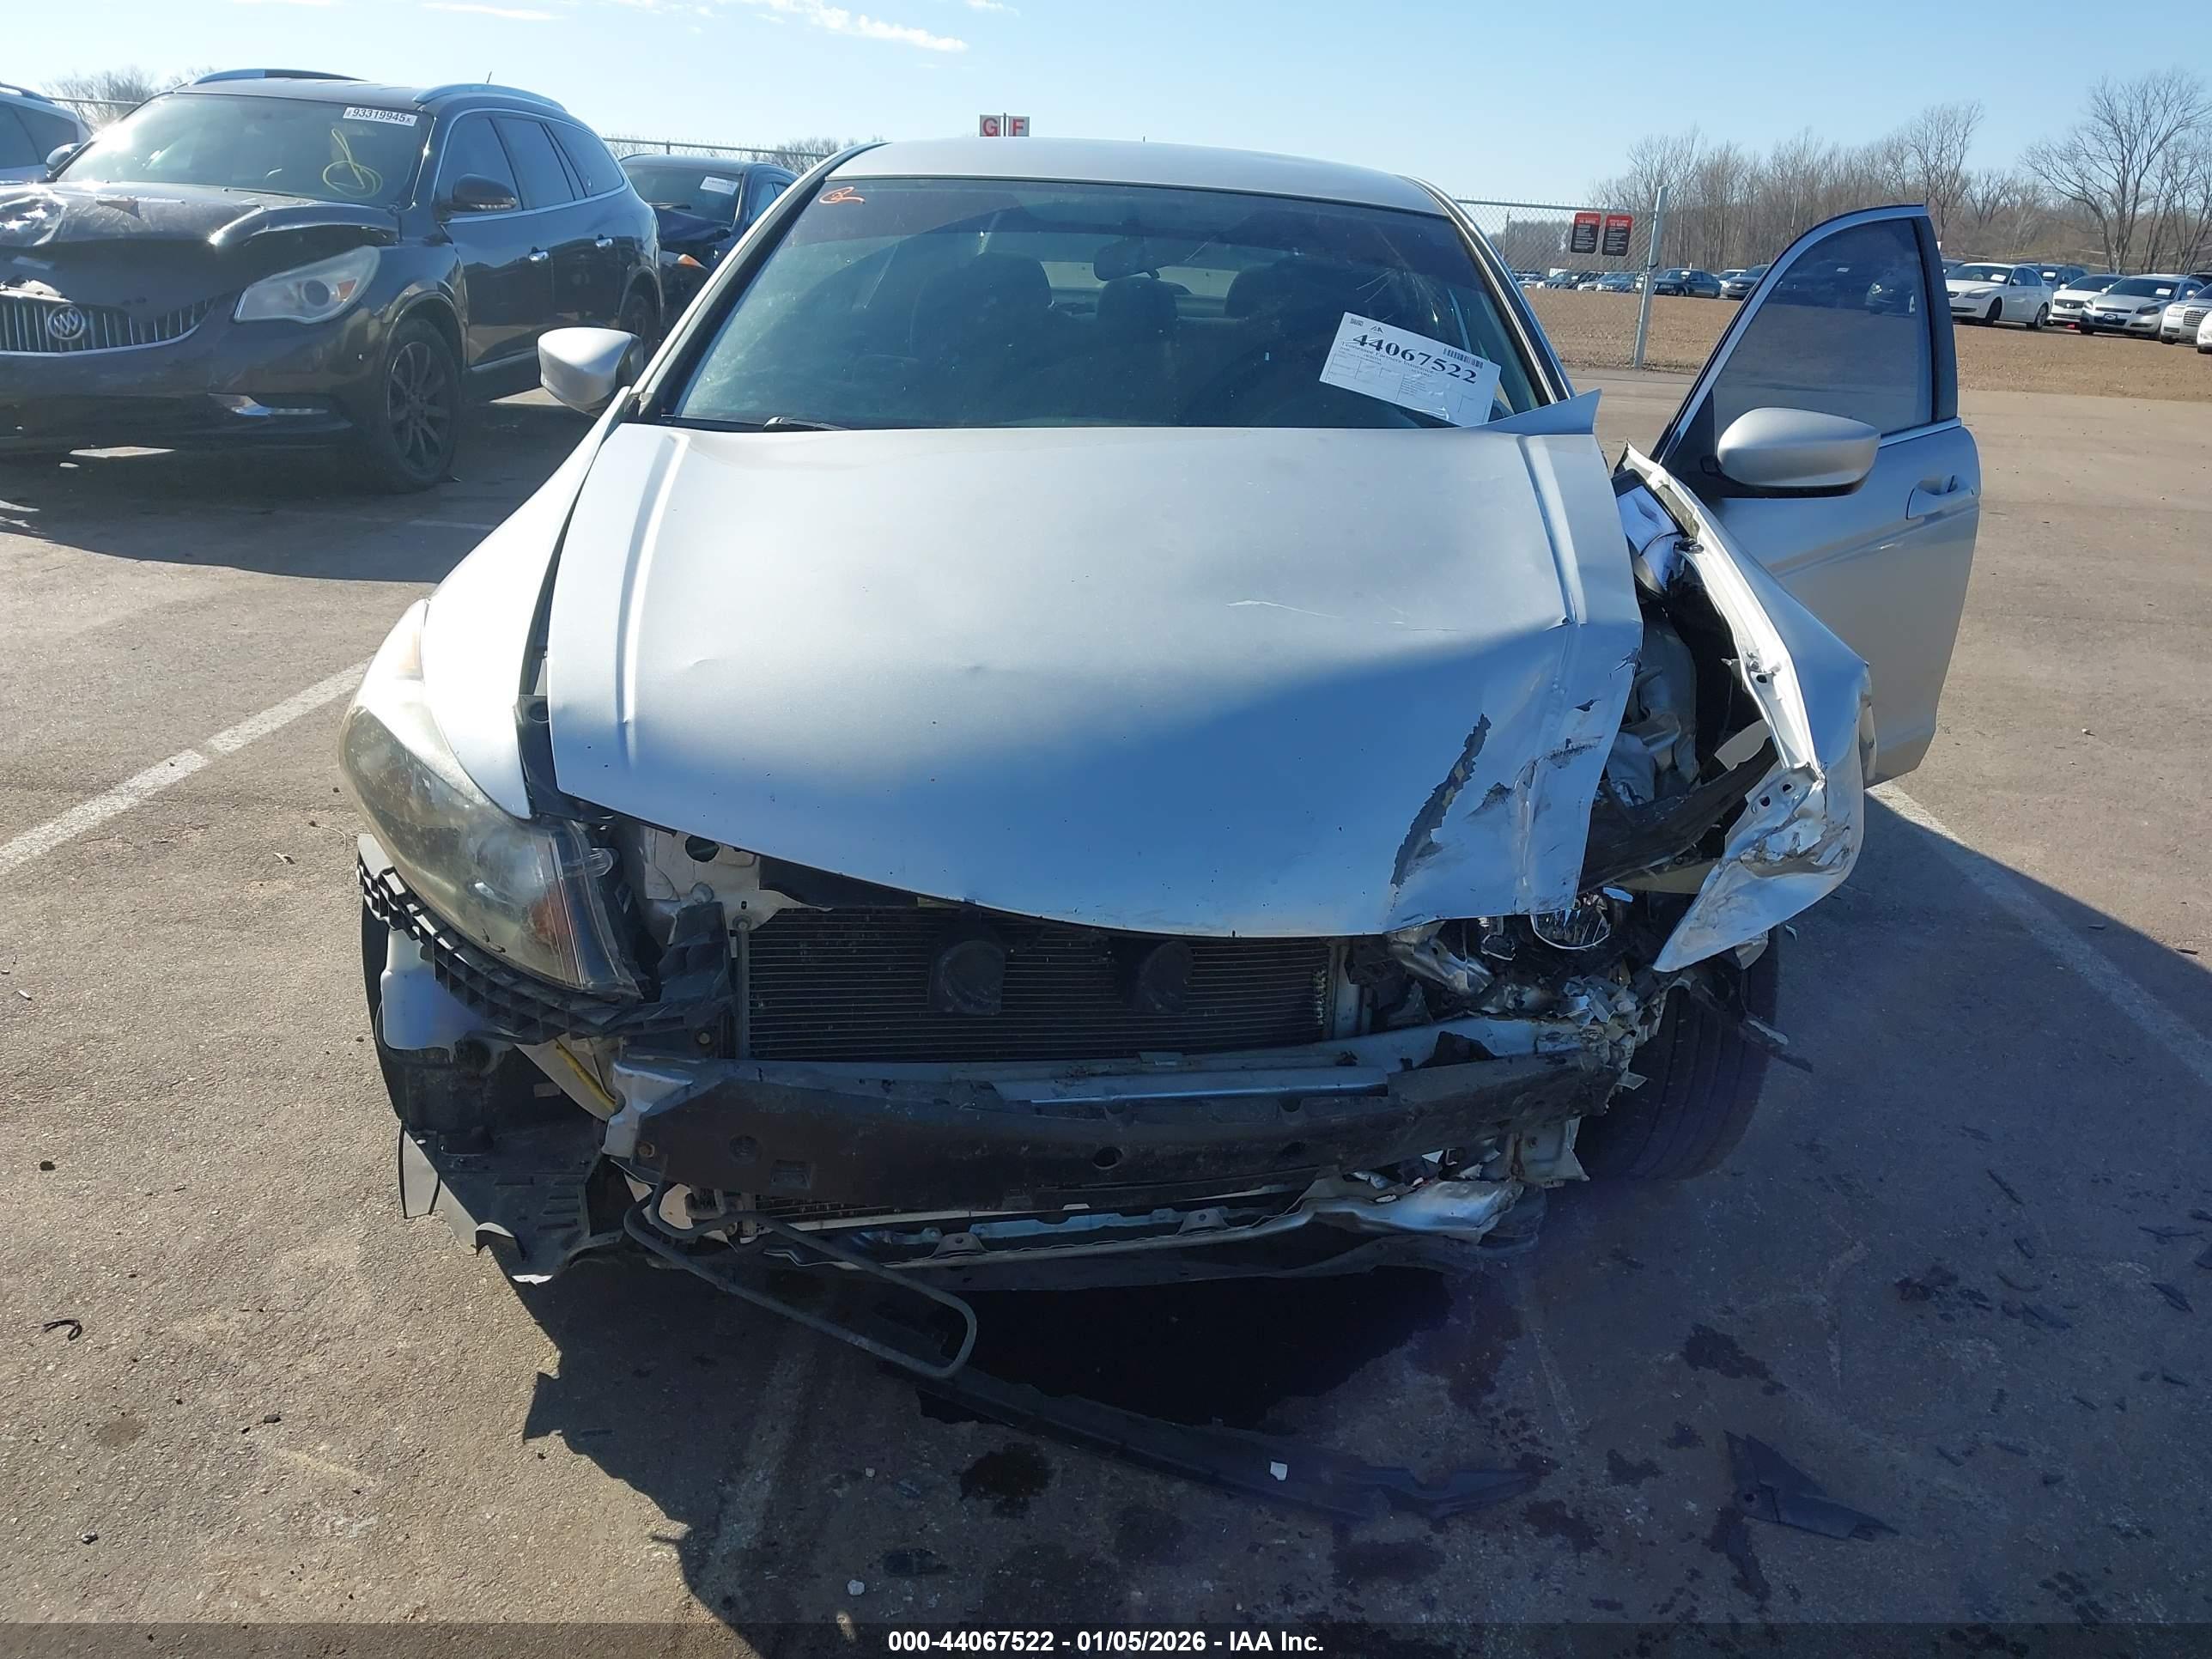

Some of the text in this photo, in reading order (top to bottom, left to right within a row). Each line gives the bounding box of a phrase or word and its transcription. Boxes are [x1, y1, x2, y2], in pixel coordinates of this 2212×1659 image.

[982, 118, 998, 137] G
[1012, 118, 1024, 137] F
[1352, 334, 1477, 384] 44067522
